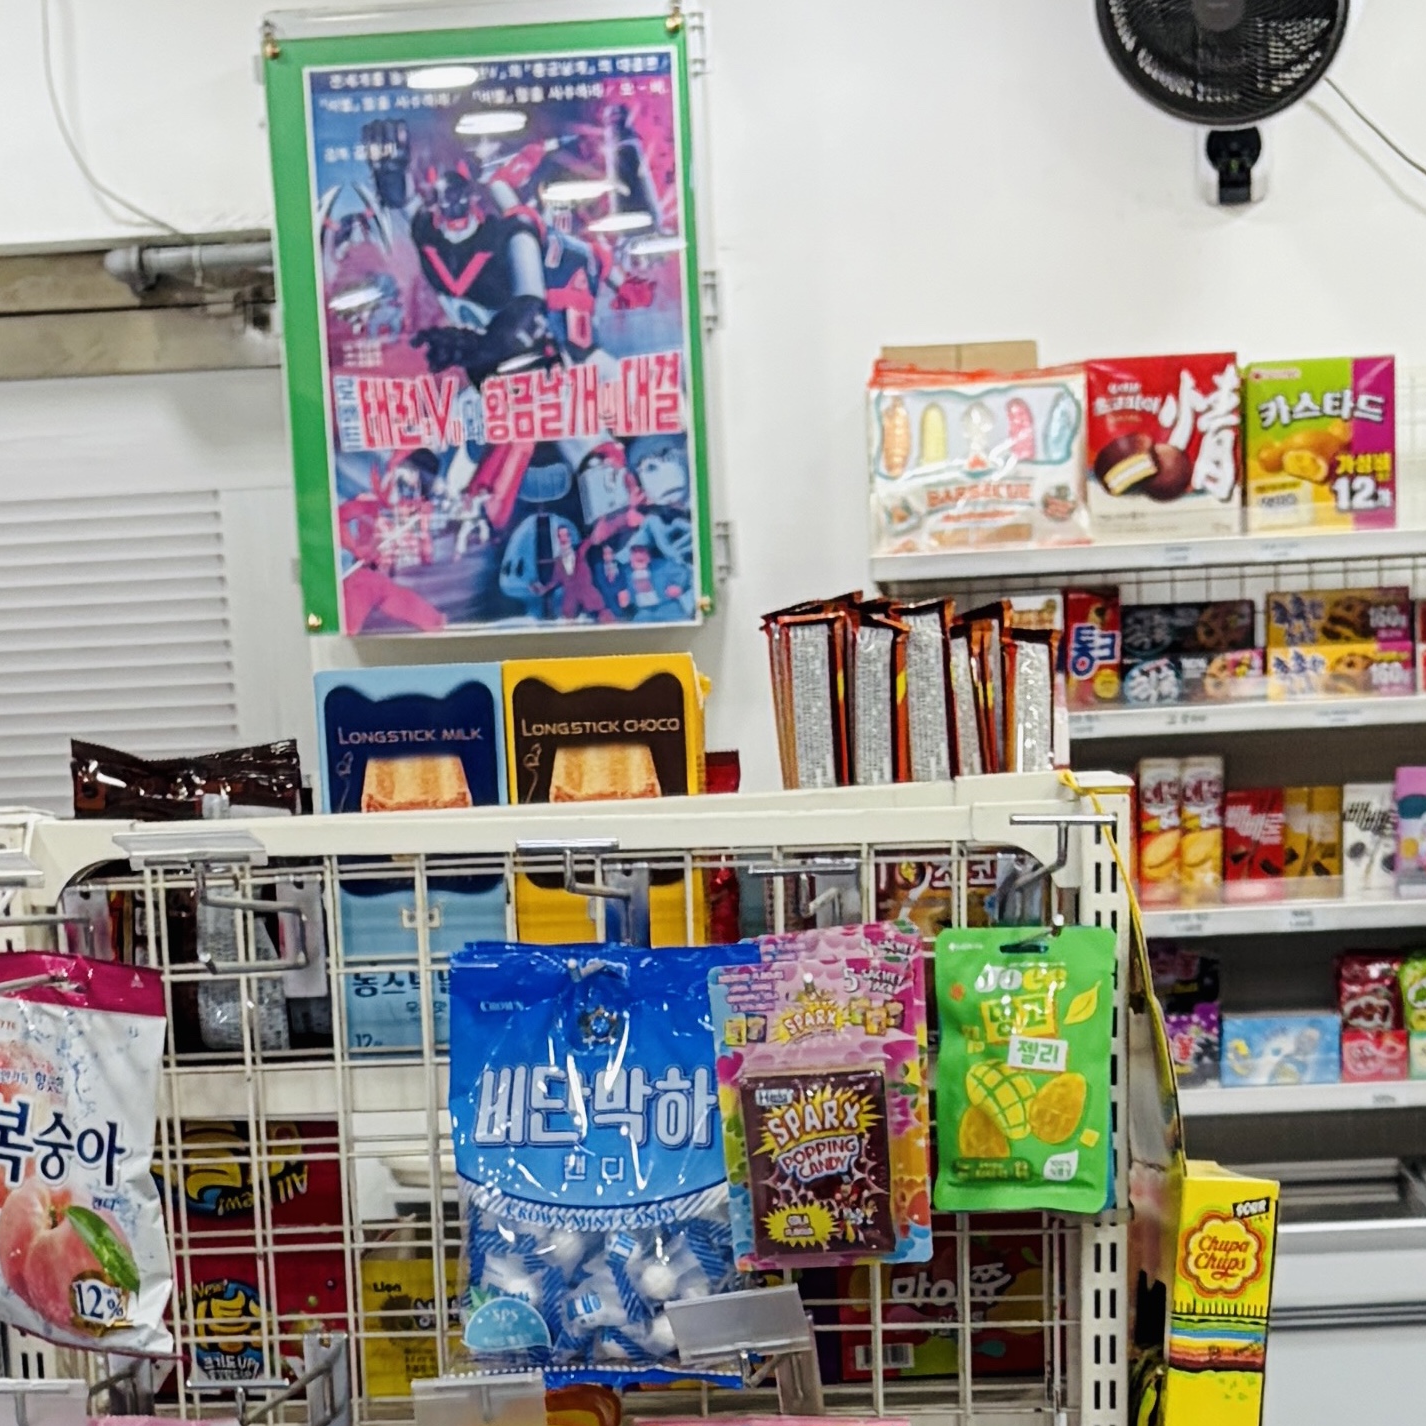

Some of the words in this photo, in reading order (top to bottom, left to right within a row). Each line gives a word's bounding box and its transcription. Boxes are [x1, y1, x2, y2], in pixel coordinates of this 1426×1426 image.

[620, 351, 684, 437] 대결
[1259, 388, 1386, 427] 카스타드
[337, 726, 437, 745] LONGSTICK
[441, 726, 483, 741] MILK
[521, 717, 621, 738] LONGSTICK
[623, 717, 681, 733] CHOCO
[842, 967, 861, 992] 5
[783, 1010, 837, 1035] SPARX
[1015, 1038, 1060, 1067] 젤리
[473, 1064, 720, 1149] 비단박하
[766, 1100, 862, 1149] SPARX
[778, 1135, 859, 1170] POPPING
[797, 1156, 851, 1182] CANDY
[1235, 1199, 1268, 1218] SOUR
[1197, 1234, 1250, 1256] Chupa
[1193, 1250, 1248, 1277] Chups
